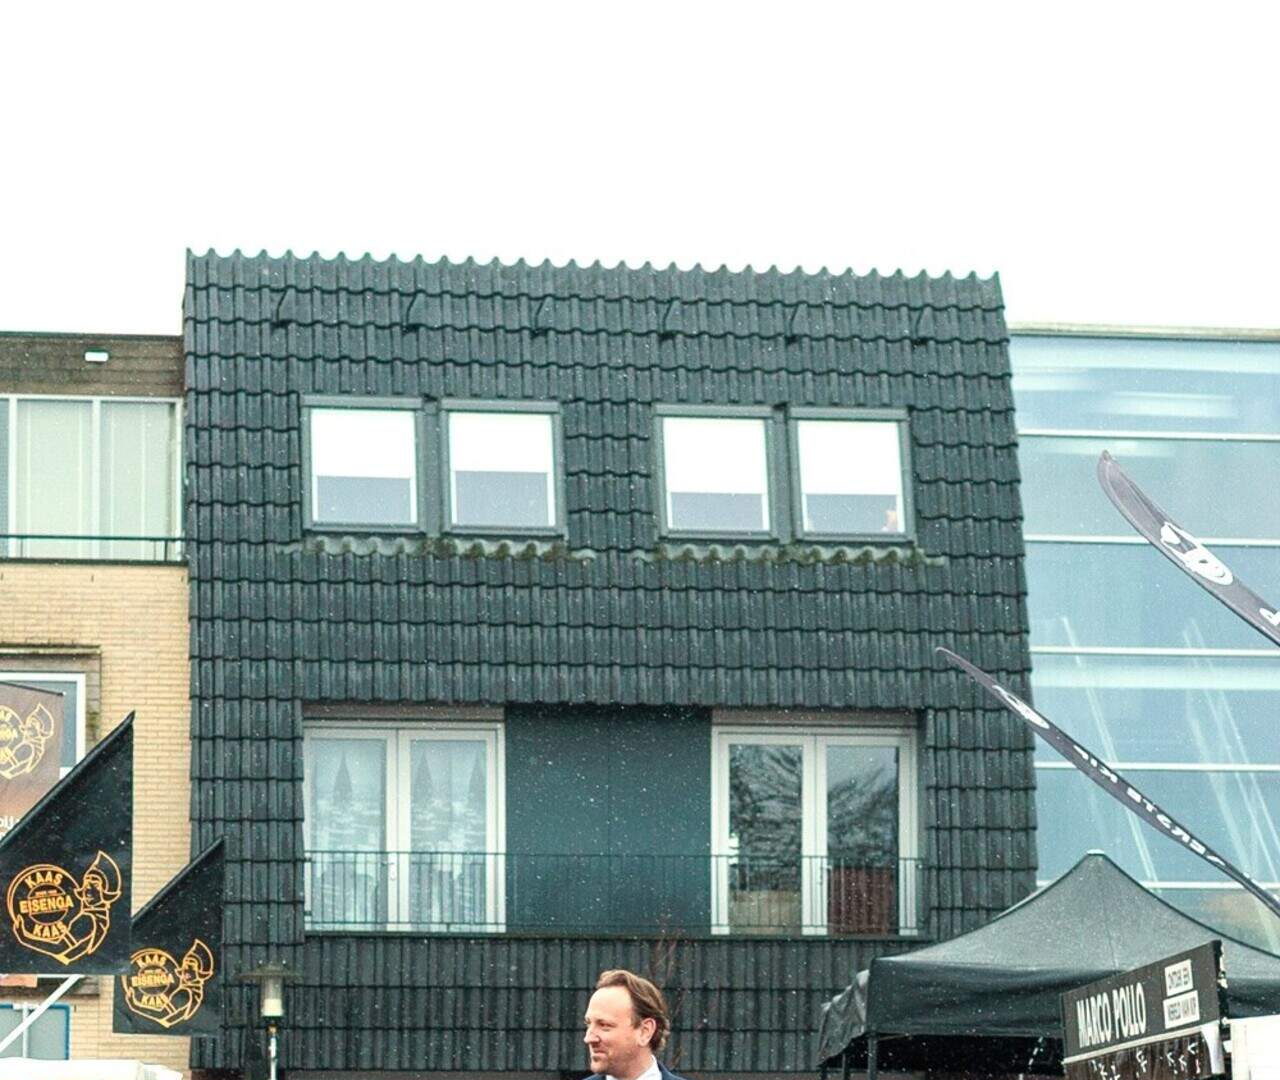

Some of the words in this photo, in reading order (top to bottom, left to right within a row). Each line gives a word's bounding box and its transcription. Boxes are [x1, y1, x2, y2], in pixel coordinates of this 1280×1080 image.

[24, 871, 64, 889] KAAS
[19, 894, 74, 914] EISENGA
[33, 920, 68, 938] KAAS
[136, 953, 167, 969] KAAS
[131, 972, 175, 988] EISENGA
[1076, 991, 1112, 1049] MARCO
[1112, 981, 1147, 1040] POLLO
